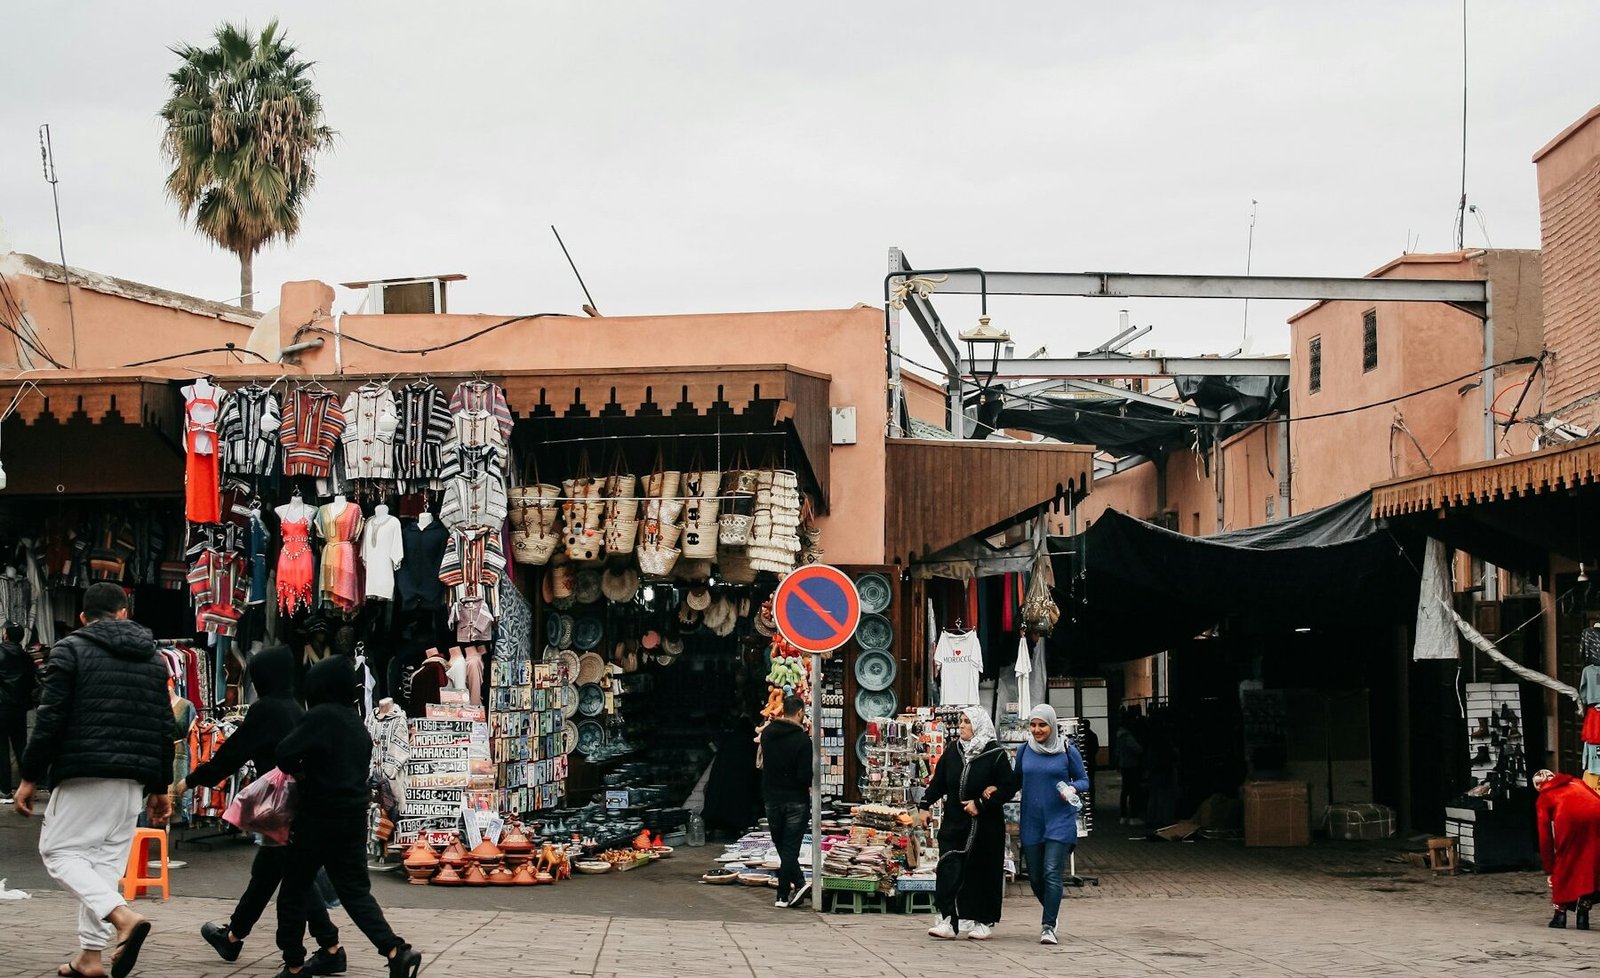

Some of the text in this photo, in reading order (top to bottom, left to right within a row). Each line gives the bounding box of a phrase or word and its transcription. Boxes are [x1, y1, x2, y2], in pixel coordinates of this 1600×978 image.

[420, 721, 436, 730] 1960
[416, 734, 452, 744] MOROCCO
[412, 748, 460, 758] MARRAKECH
[410, 764, 430, 774] 1958
[406, 790, 430, 800] 31548
[447, 791, 460, 800] 210
[403, 820, 420, 831] 1989
